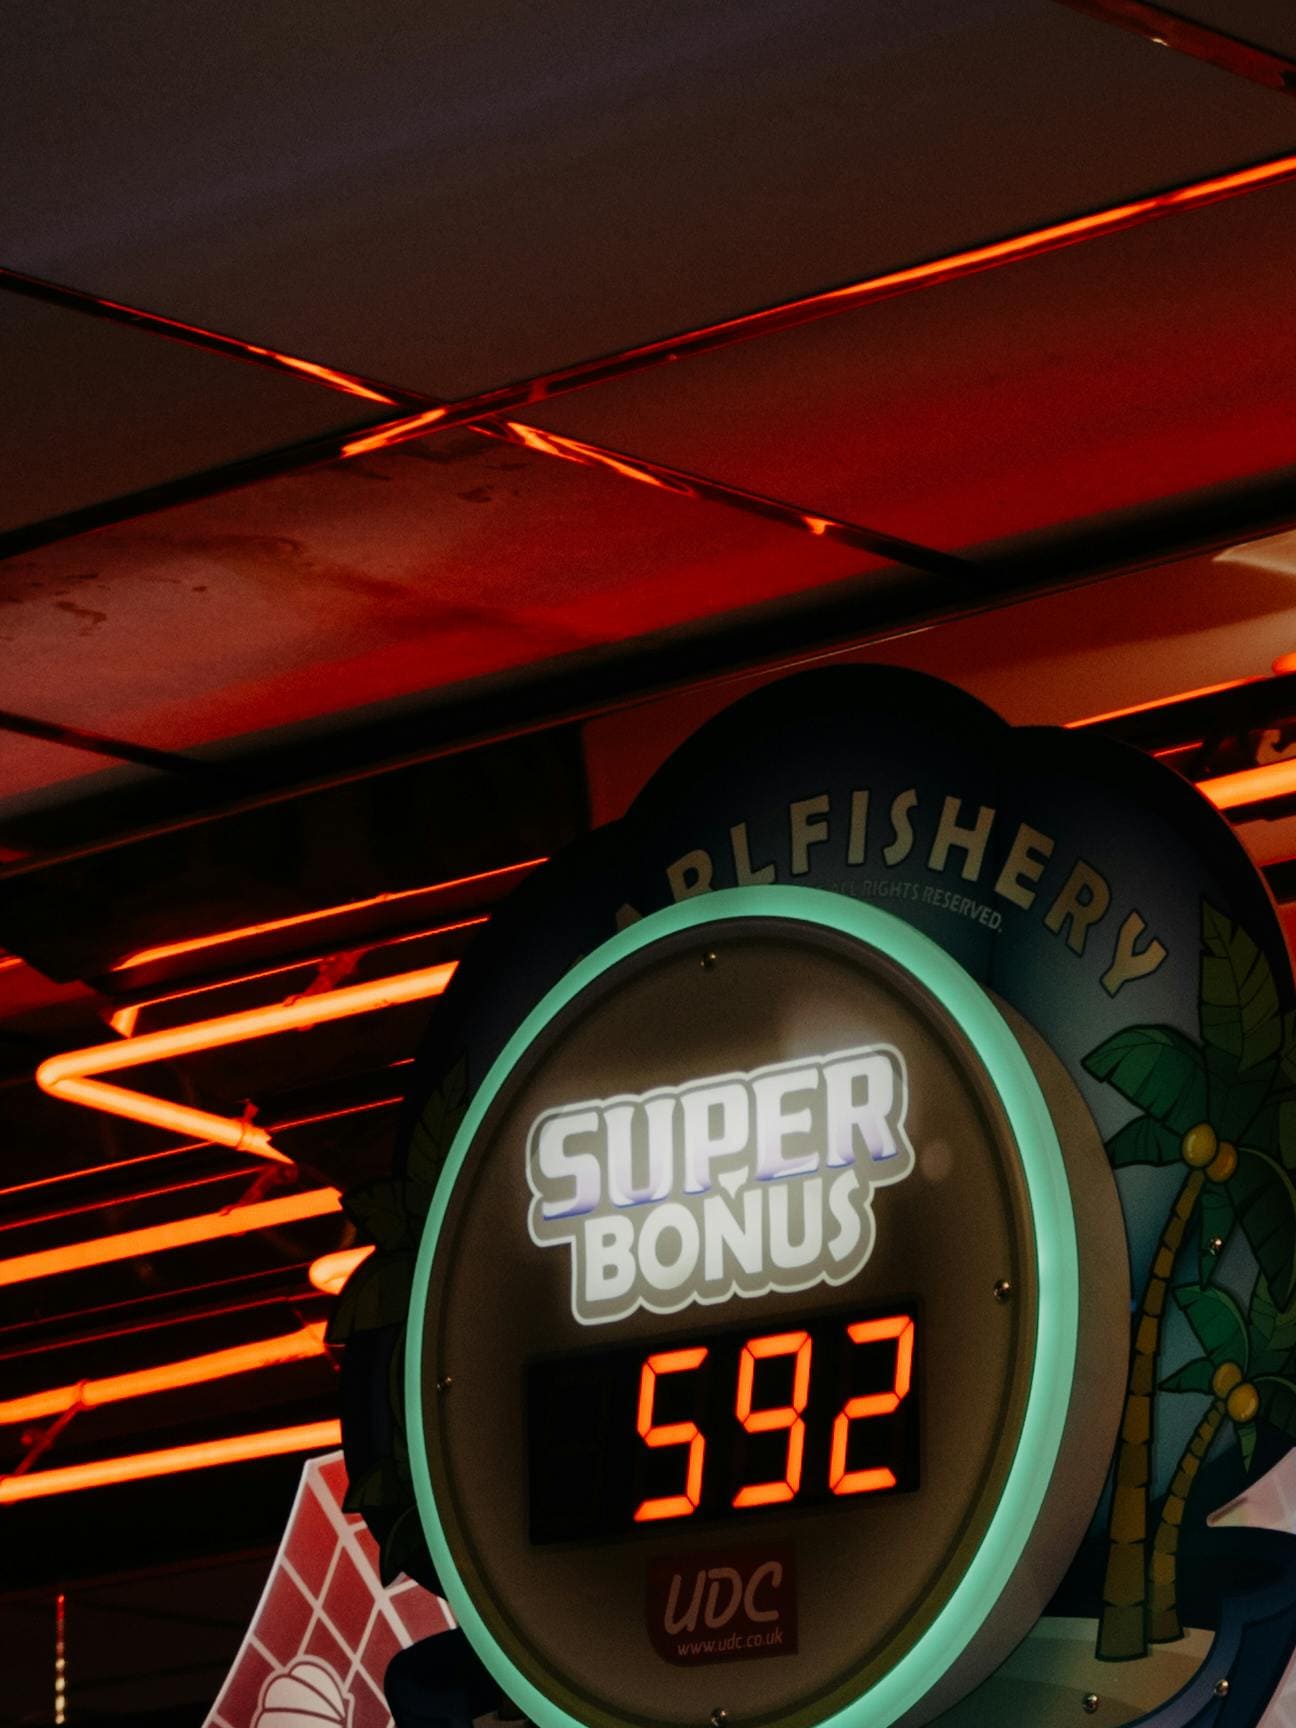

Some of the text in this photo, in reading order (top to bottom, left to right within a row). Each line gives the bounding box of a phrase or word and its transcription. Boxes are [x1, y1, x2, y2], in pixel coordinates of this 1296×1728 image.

[863, 879, 920, 906] RIGHTS
[536, 1054, 899, 1222] SUPER
[585, 1166, 862, 1303] BONUS
[632, 1314, 916, 1524] 592
[664, 1560, 784, 1636] UDC
[676, 1629, 784, 1658] www.udc.co.uk
